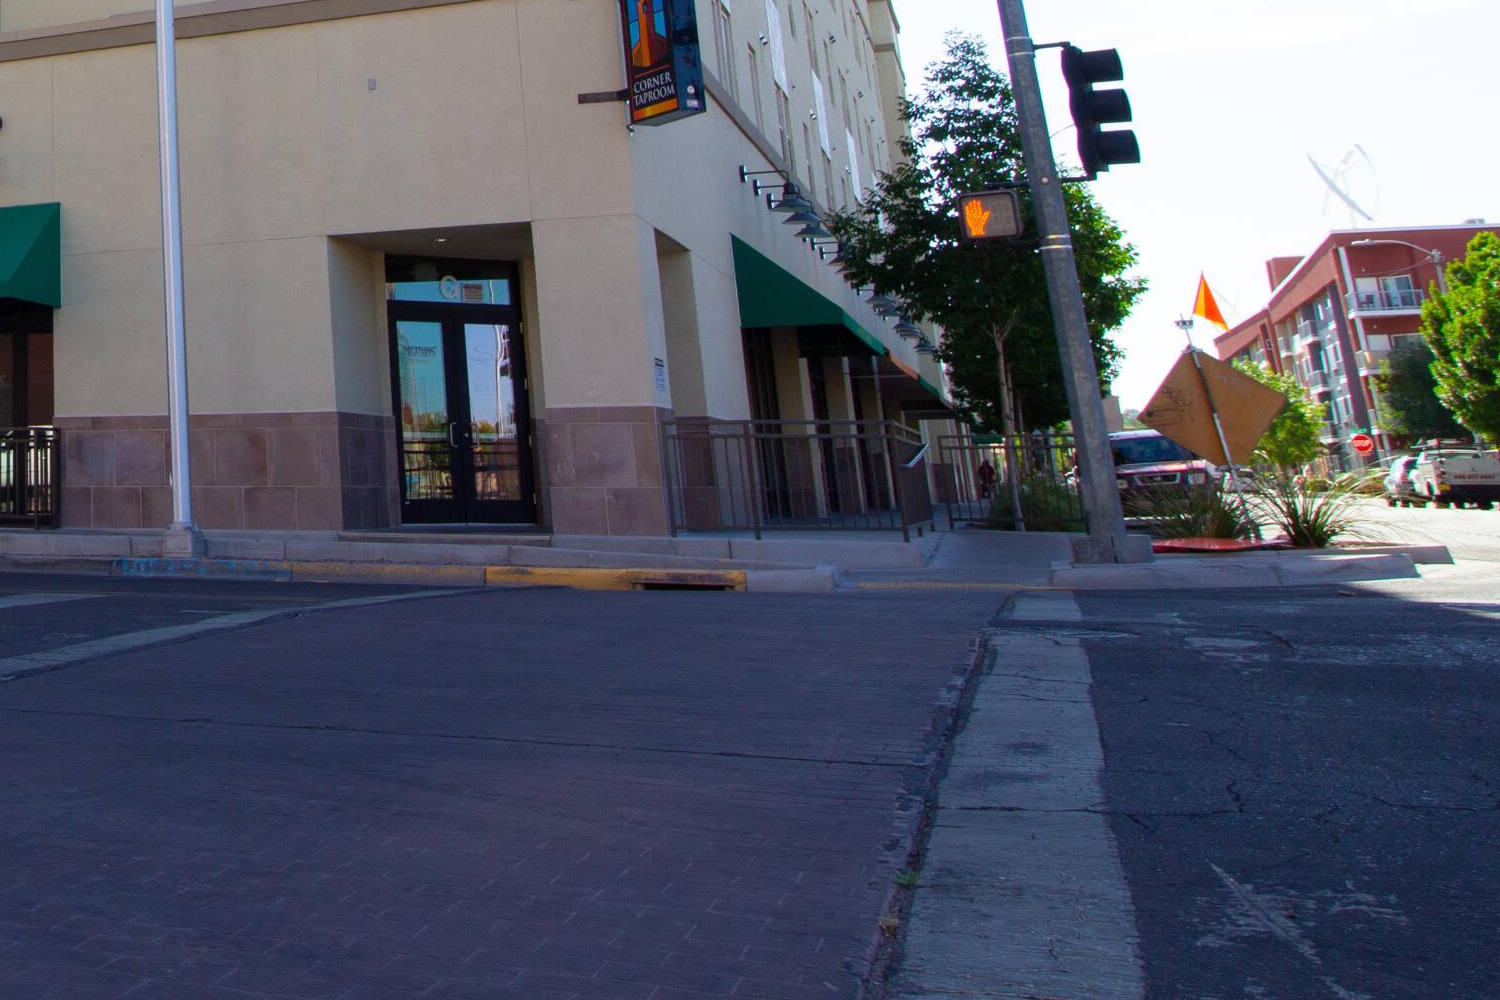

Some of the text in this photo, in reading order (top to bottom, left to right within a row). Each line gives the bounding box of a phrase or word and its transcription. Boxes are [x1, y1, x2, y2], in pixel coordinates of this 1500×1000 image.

[634, 71, 672, 93] CORNER
[634, 83, 676, 106] TAPROOM
[1353, 439, 1371, 447] STOP
